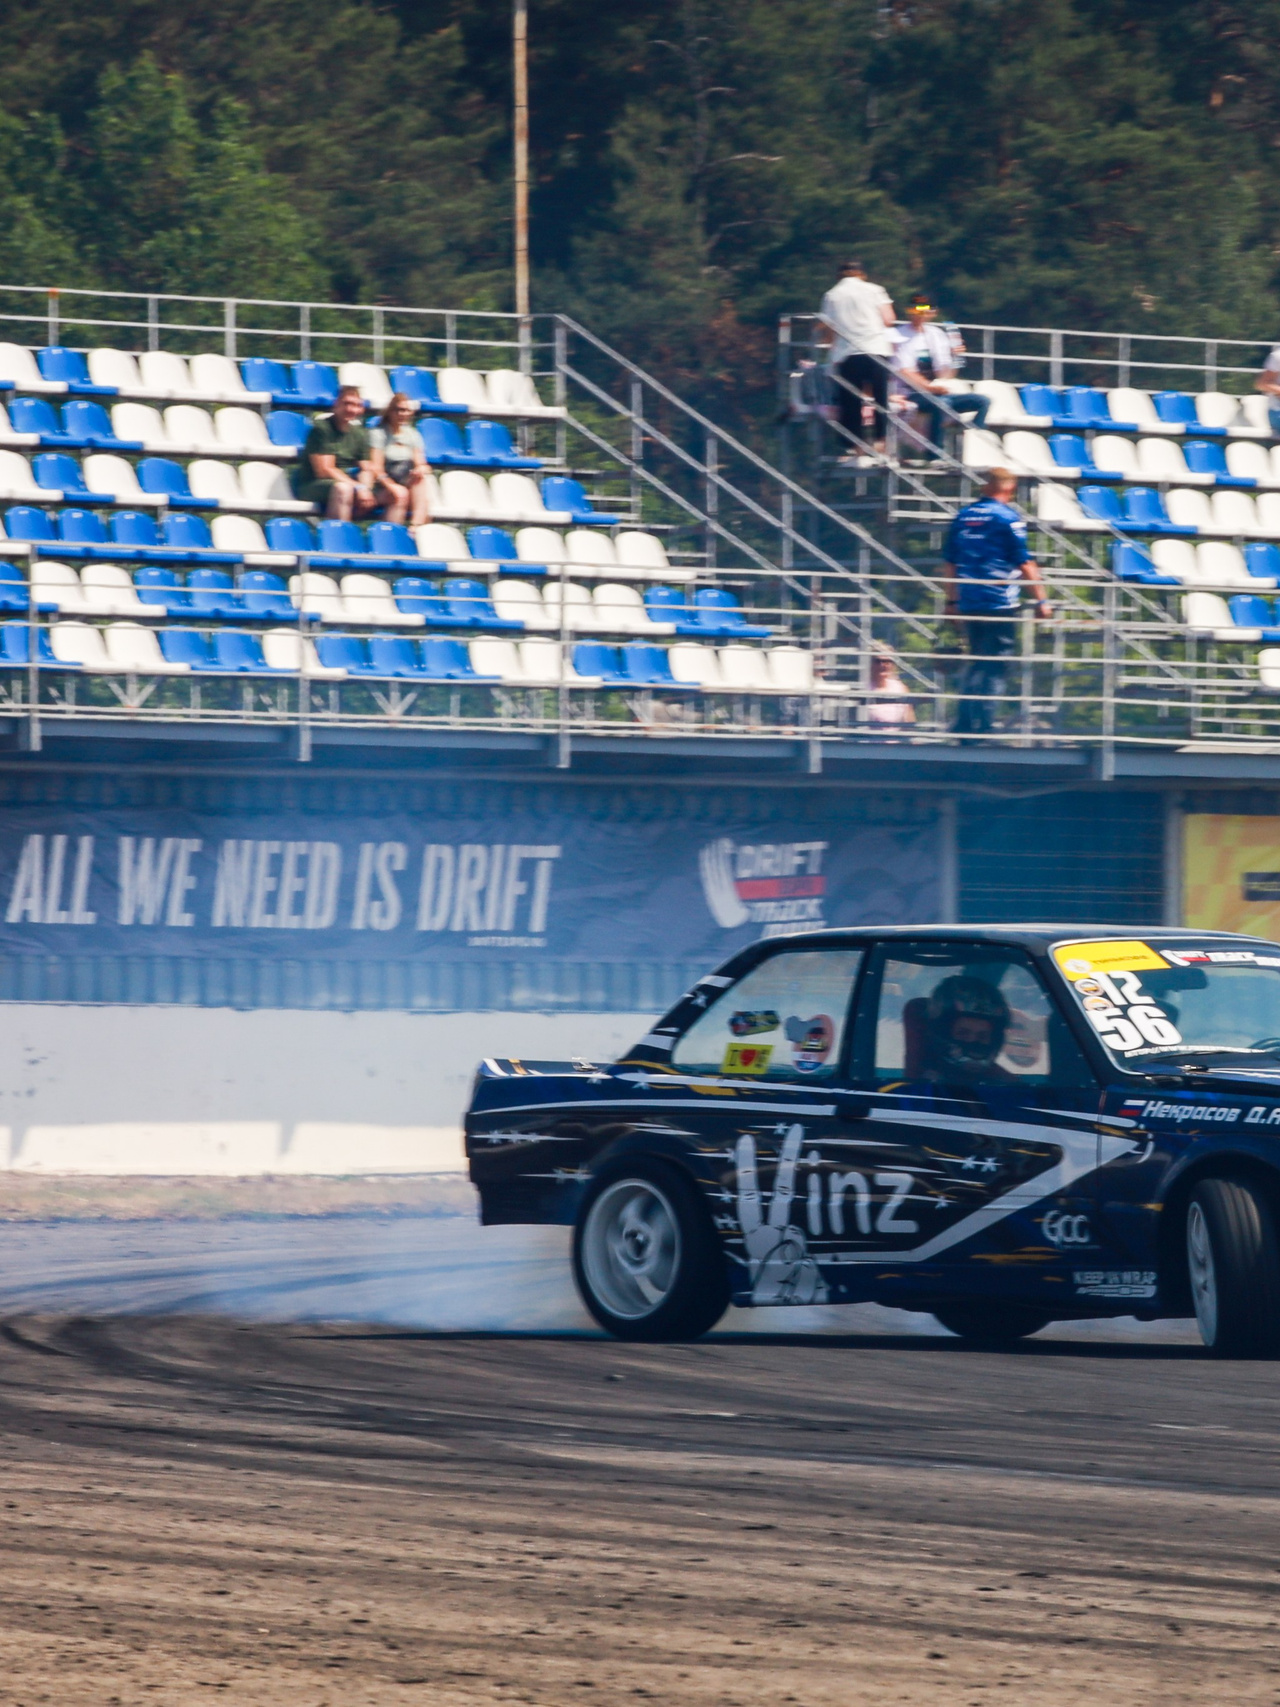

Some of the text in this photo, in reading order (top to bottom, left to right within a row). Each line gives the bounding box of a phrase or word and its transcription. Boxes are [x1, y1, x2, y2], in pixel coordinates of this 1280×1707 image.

[737, 841, 829, 878] DRIFT
[5, 834, 562, 932] ALL WE NEED IS DRIFT
[1089, 970, 1156, 1006] 12
[1086, 1005, 1183, 1051] 56
[1142, 1100, 1242, 1123] Некрасов
[735, 1123, 920, 1240] Vinz
